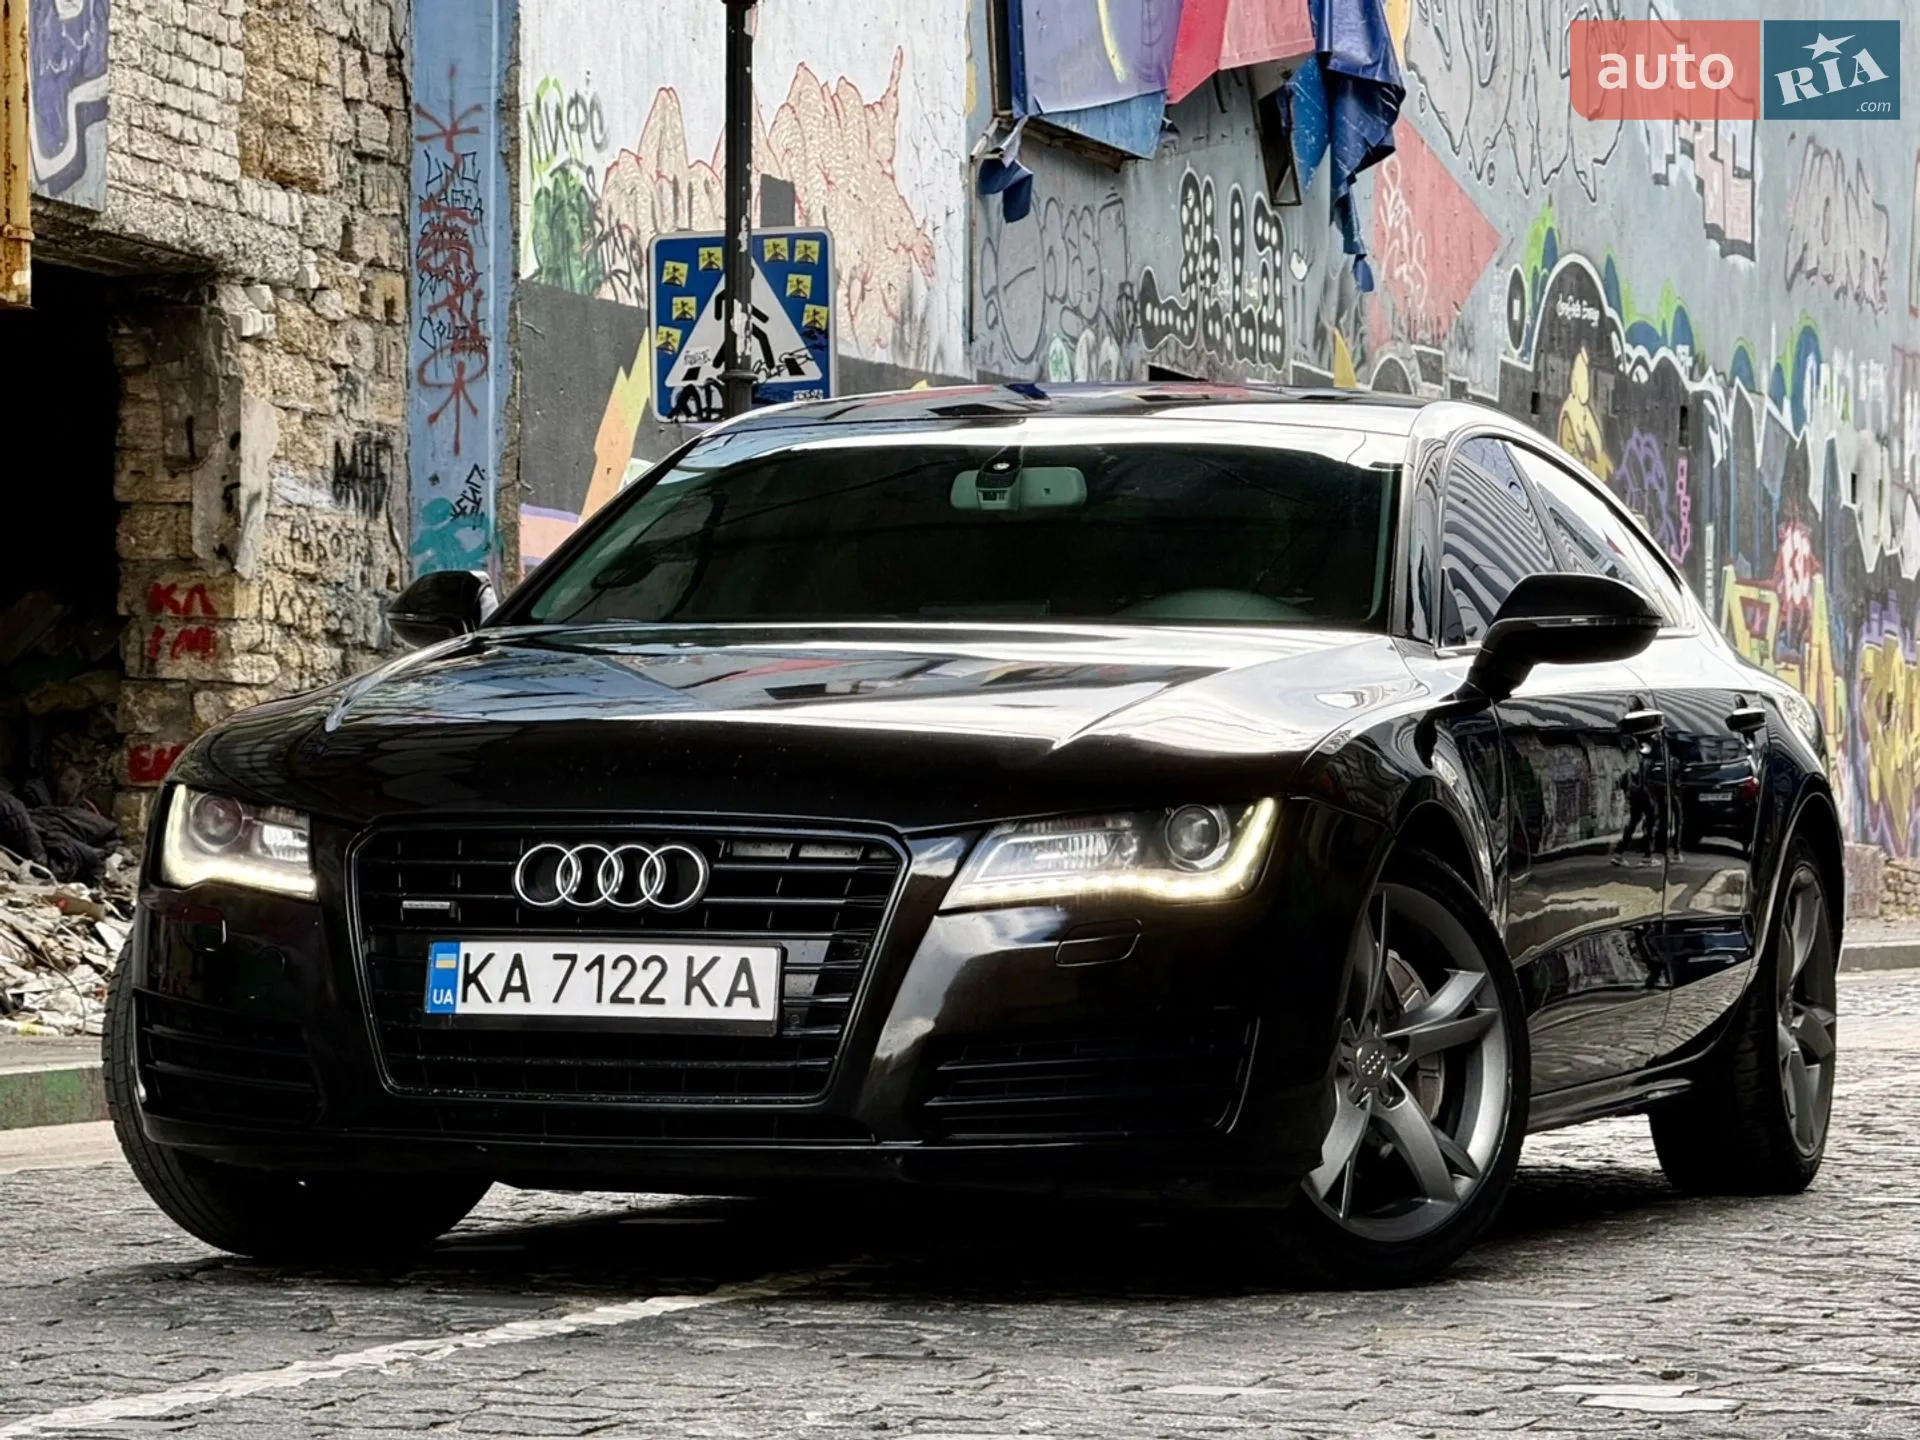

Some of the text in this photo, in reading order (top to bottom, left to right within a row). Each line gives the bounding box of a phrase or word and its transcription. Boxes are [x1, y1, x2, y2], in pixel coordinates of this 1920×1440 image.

[433, 988, 454, 1005] UA
[461, 952, 760, 1008] KA 7122 KA
